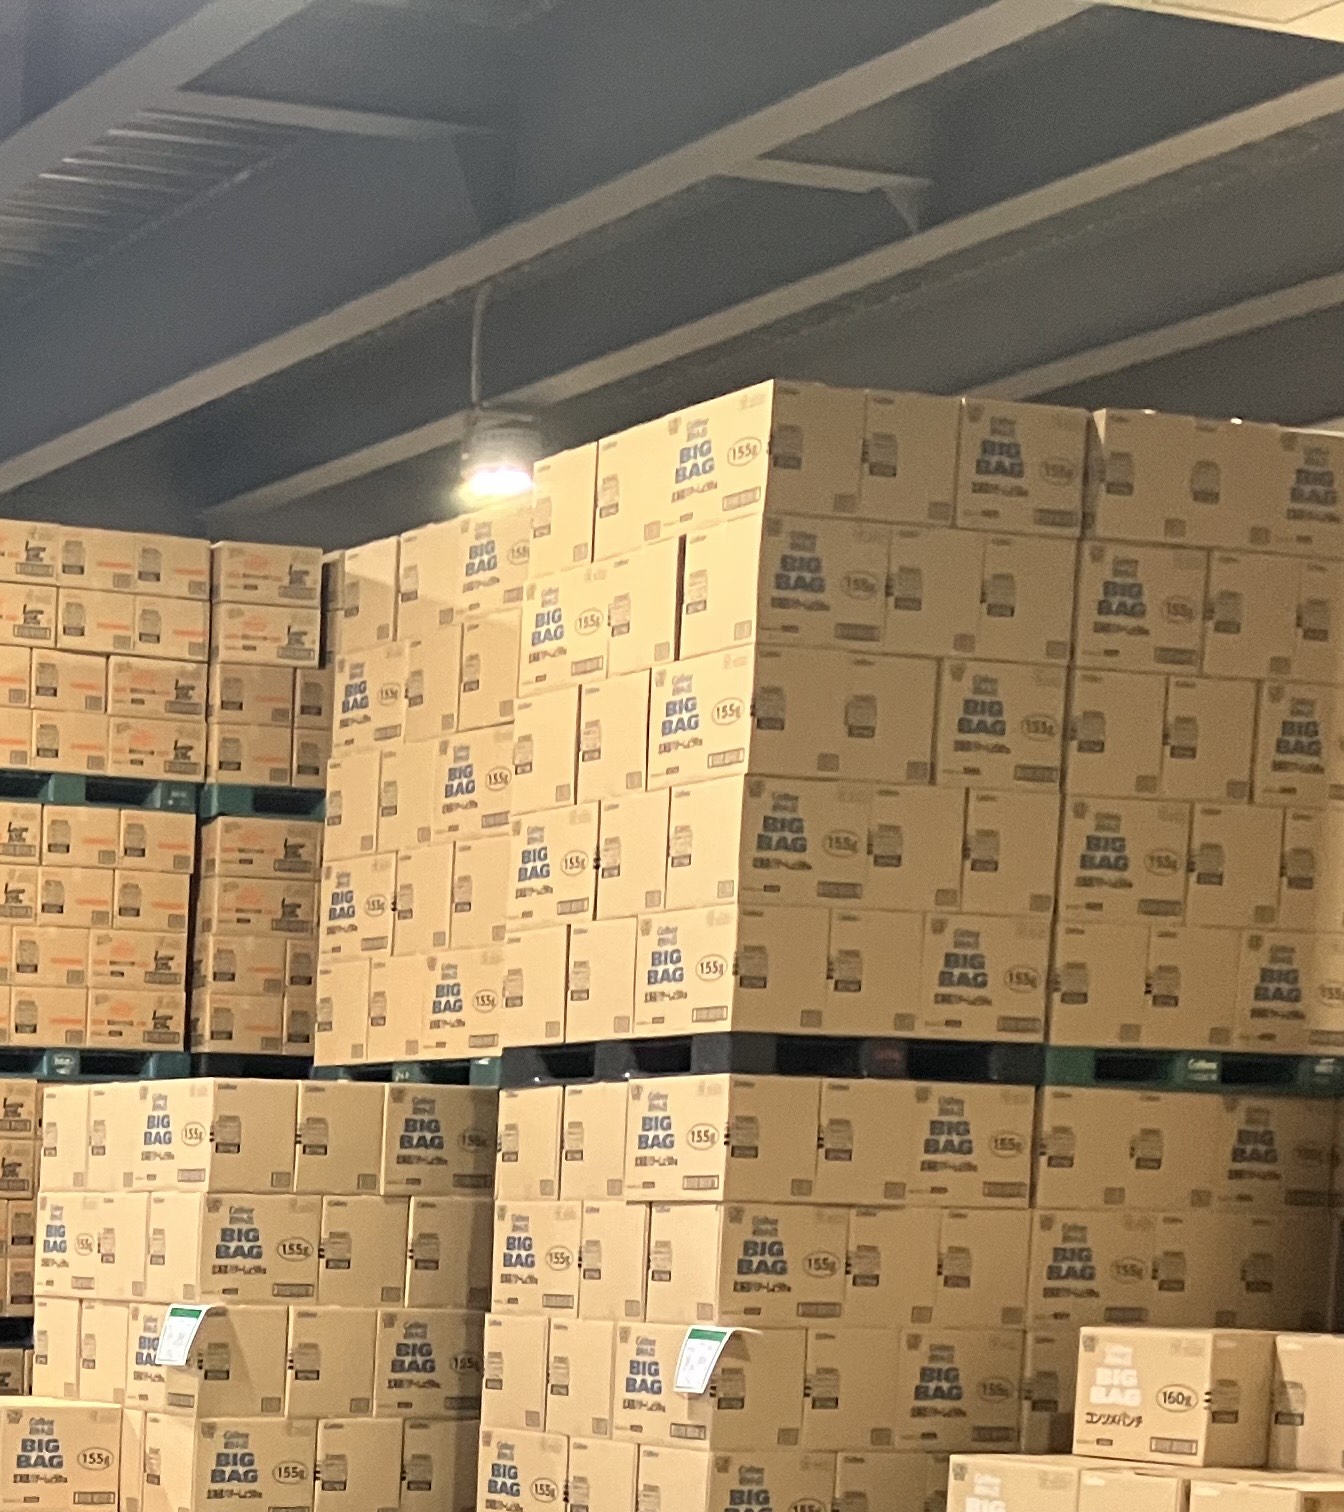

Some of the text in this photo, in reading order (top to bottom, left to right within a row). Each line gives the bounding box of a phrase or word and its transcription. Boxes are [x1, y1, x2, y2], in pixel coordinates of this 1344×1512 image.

[679, 439, 712, 464] BIG
[675, 457, 714, 484] BAG
[535, 608, 562, 628] BIG
[532, 625, 564, 647] BAG
[345, 680, 367, 698] BIG
[342, 696, 369, 714] BAG
[665, 697, 697, 717] BIG
[963, 700, 1004, 716] BIG
[662, 714, 699, 737] BAG
[957, 718, 1006, 736] BAG
[1282, 720, 1319, 738] BIG
[1276, 737, 1322, 757] BAG
[448, 763, 474, 781] BIG
[445, 780, 475, 798] BAG
[762, 815, 804, 834] BIG
[756, 834, 807, 853] BAG
[1086, 835, 1126, 853] BIG
[521, 847, 548, 865] BIG
[1080, 853, 1129, 872] BAG
[518, 864, 550, 882] BAG
[331, 890, 354, 906] BIG
[329, 905, 356, 921] BAG
[651, 949, 682, 967] BIG
[944, 953, 985, 970] BIG
[647, 967, 684, 985] BAG
[938, 971, 988, 988] BAG
[436, 983, 461, 998] BIG
[432, 999, 463, 1015] BAG
[147, 1114, 171, 1130] BIG
[404, 1118, 441, 1133] BIG
[642, 1116, 672, 1132] BIG
[929, 1120, 970, 1136] BIG
[143, 1130, 172, 1146] BAG
[399, 1135, 444, 1149] BAG
[638, 1133, 675, 1150] BAG
[924, 1138, 973, 1155] BAG
[45, 1225, 66, 1237] BIG
[220, 1227, 260, 1243] BIG
[43, 1240, 67, 1253] BAG
[215, 1244, 263, 1259] BAG
[506, 1236, 533, 1251] BIG
[743, 1240, 784, 1257] BIG
[502, 1253, 535, 1268] BAG
[1052, 1247, 1092, 1262] BIG
[737, 1258, 787, 1275] BAG
[1046, 1264, 1096, 1281] BAG
[135, 1351, 162, 1366] BA
[395, 1343, 433, 1358] BIG
[391, 1360, 435, 1374] BAG
[629, 1359, 660, 1376] BIG
[919, 1366, 960, 1383] BIG
[1095, 1367, 1137, 1386] BIG
[625, 1377, 662, 1395] BAG
[914, 1384, 963, 1401] BAG
[1089, 1386, 1143, 1408] BAG
[1162, 1390, 1192, 1408] 160g
[20, 1438, 60, 1453] BIG
[16, 1454, 64, 1469] BAG
[82, 1453, 110, 1466] 155g
[215, 1452, 255, 1467] BIG
[210, 1469, 259, 1484] BAG
[491, 1463, 518, 1480] BIG
[487, 1479, 520, 1497] BAG
[729, 1489, 770, 1506] BIG
